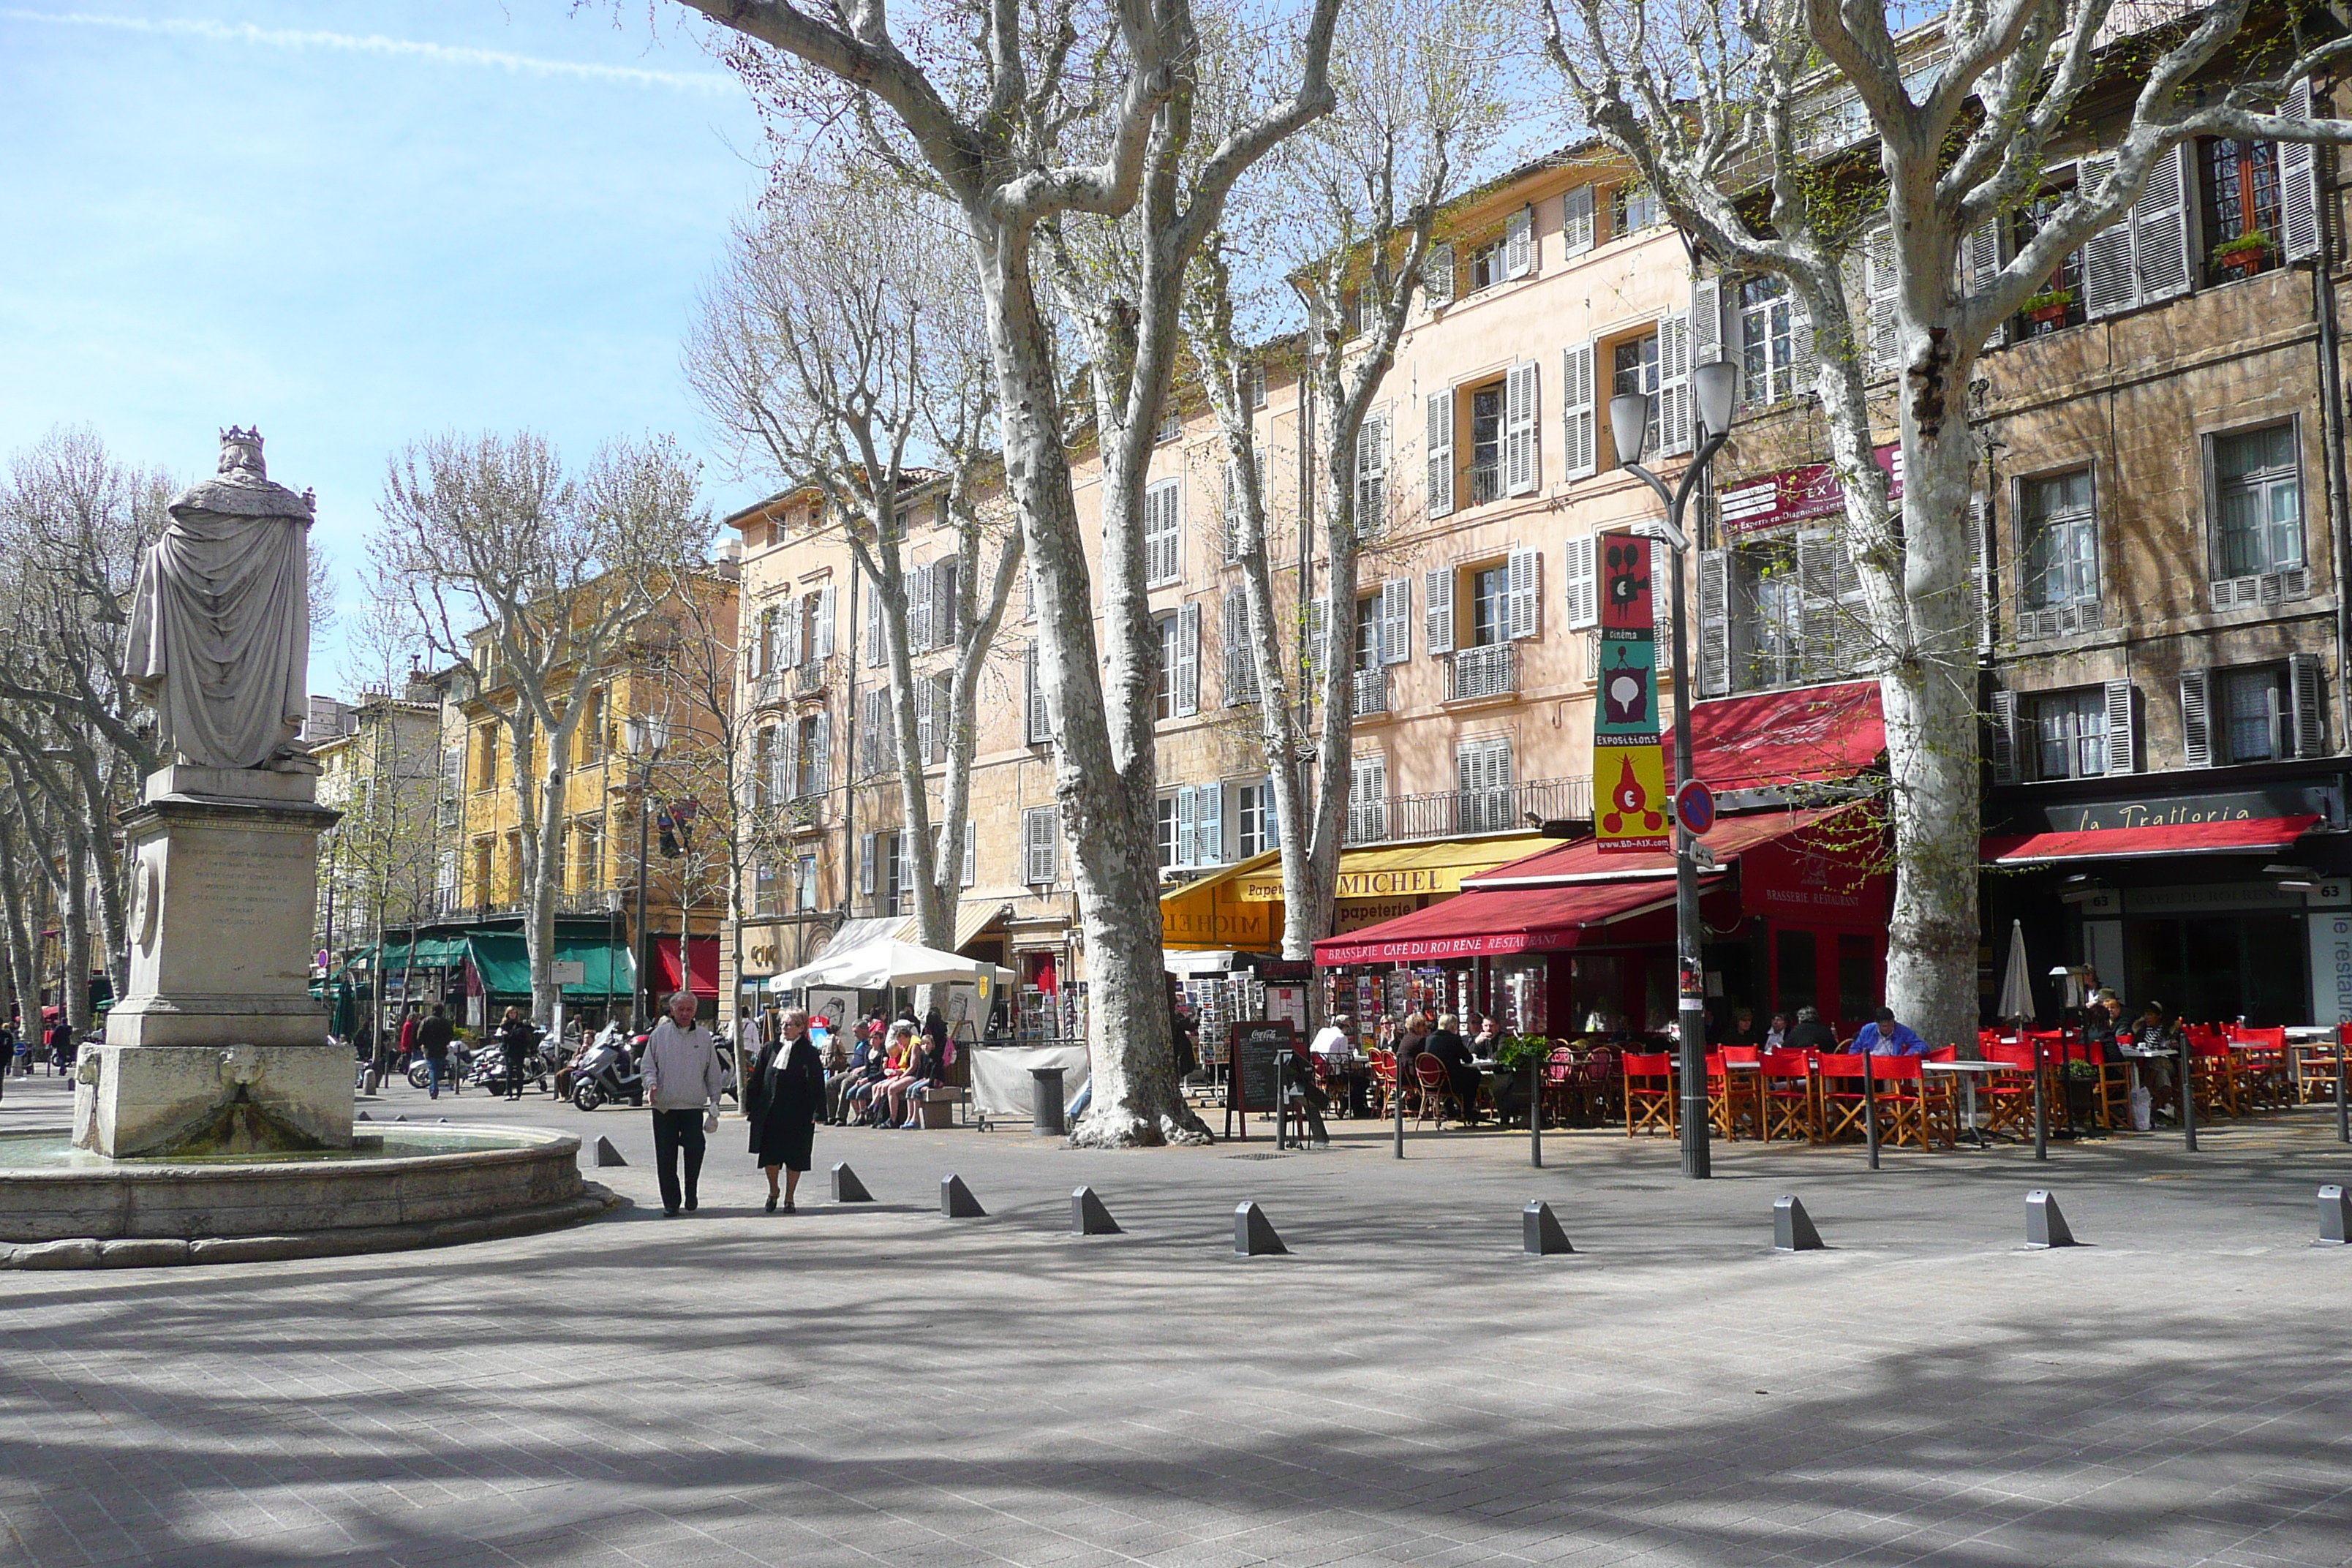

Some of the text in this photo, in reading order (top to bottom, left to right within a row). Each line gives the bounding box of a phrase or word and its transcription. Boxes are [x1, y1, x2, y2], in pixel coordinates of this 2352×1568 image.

[1609, 628, 1637, 641] cinéma
[2118, 804, 2250, 829] Trattoria
[1248, 882, 1285, 898] Papet
[1338, 870, 1444, 894] MICHEL
[1765, 889, 1860, 907] BRASSERIE RESTAURANT
[2320, 886, 2340, 897] 63
[2092, 896, 2109, 906] 63
[1341, 902, 1412, 921] papeterie
[1327, 933, 1561, 960] BRASSERIE CAFÉ DU ROI RENÉ RESTAURANT
